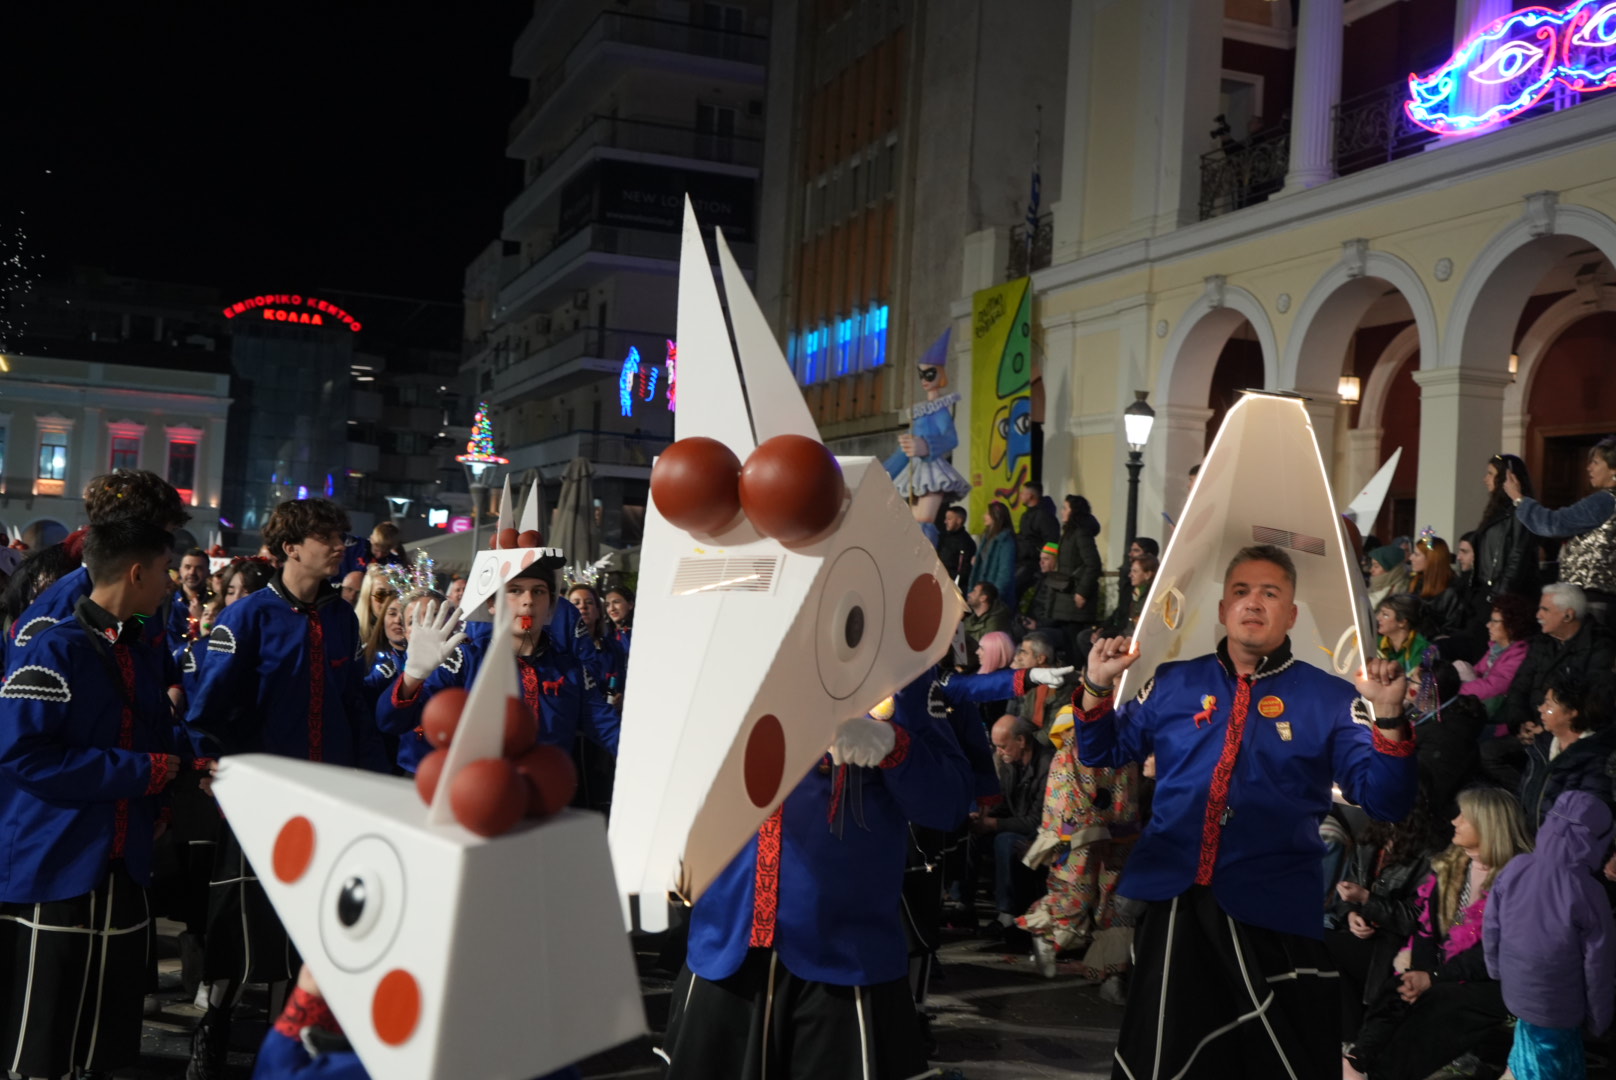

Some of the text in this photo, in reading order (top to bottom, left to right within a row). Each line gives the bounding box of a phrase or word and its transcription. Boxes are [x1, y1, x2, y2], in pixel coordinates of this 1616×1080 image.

[622, 189, 657, 203] NEW
[223, 294, 362, 332] ΕΜΠΟΡΙΚΟ ΚΕΝΤΡΟ
